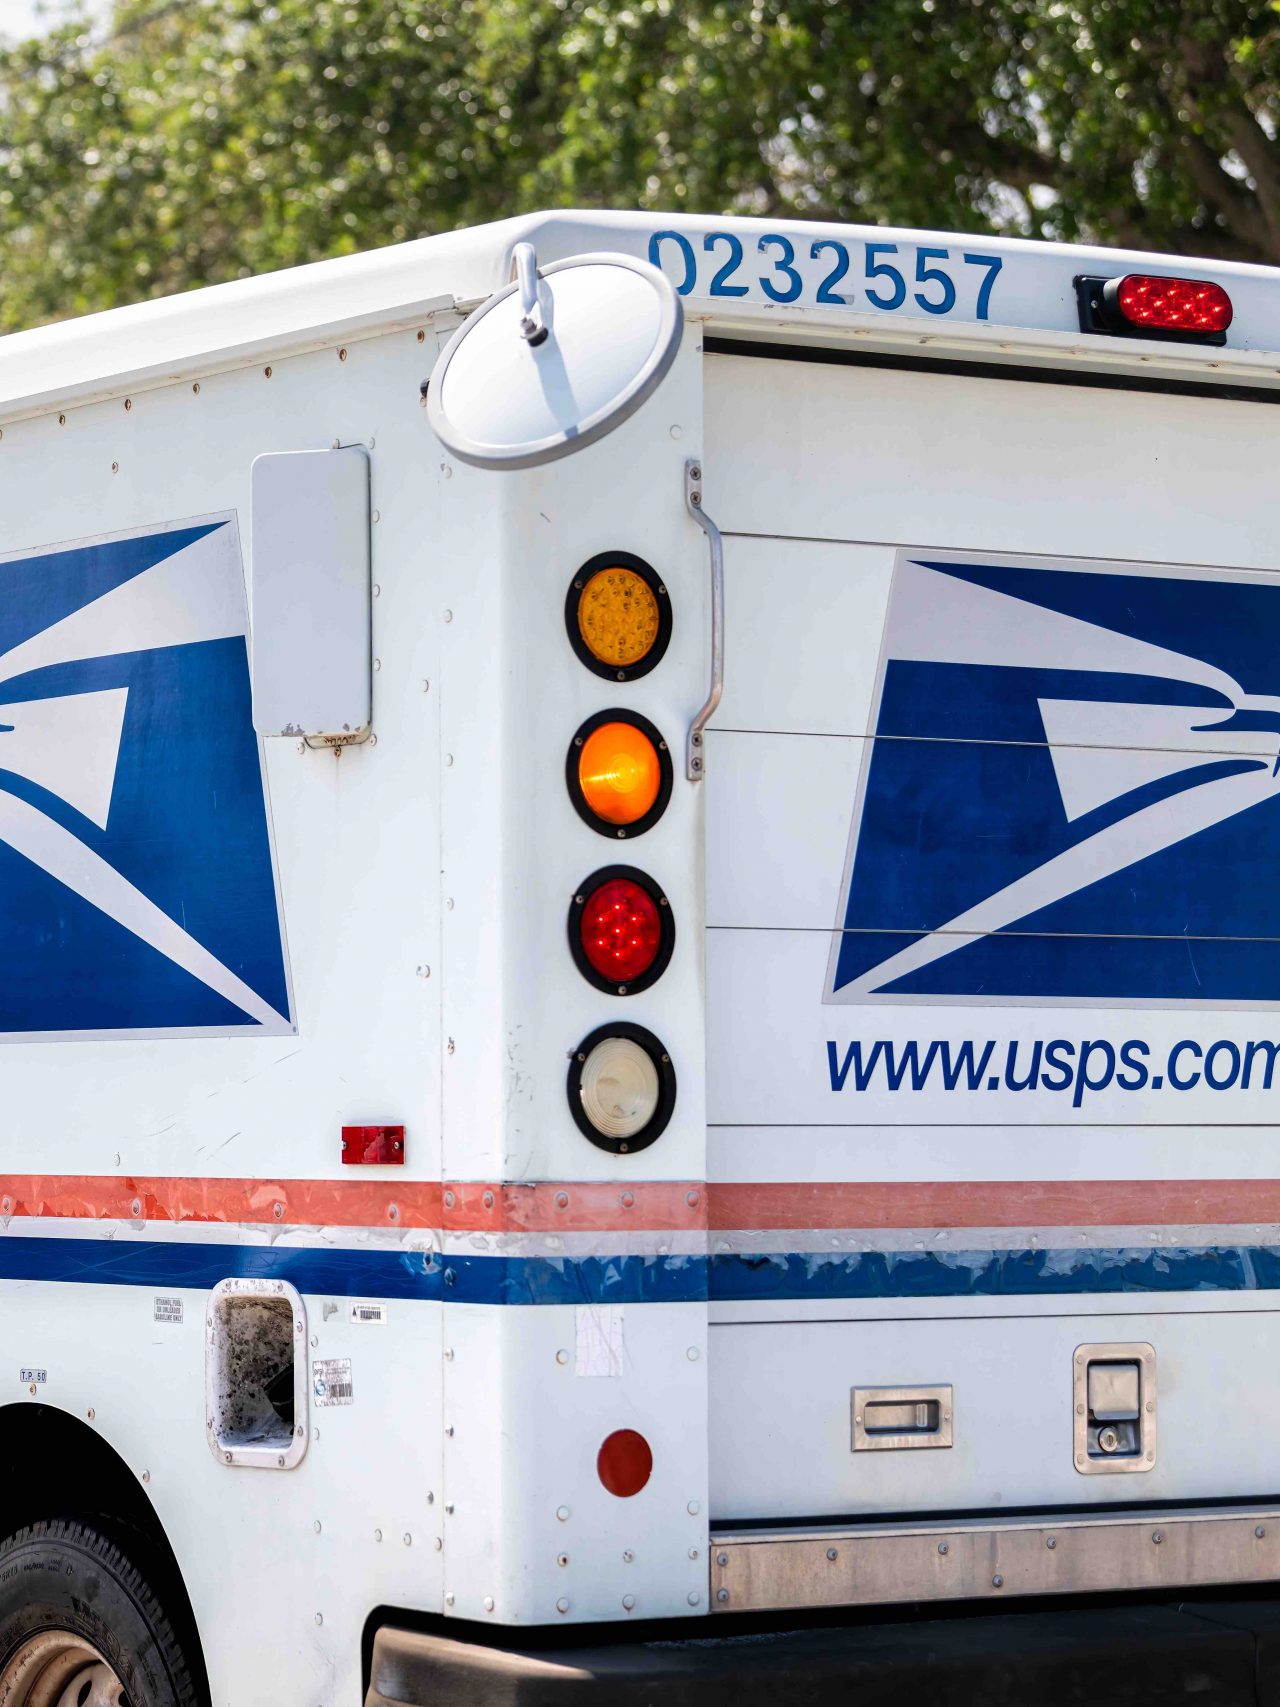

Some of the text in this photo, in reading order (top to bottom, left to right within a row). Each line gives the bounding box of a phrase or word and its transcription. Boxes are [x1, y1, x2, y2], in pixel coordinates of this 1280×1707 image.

[647, 230, 1003, 320] 0232557
[826, 1039, 1280, 1108] www.usps.com
[21, 1371, 46, 1382] T.P. 50
